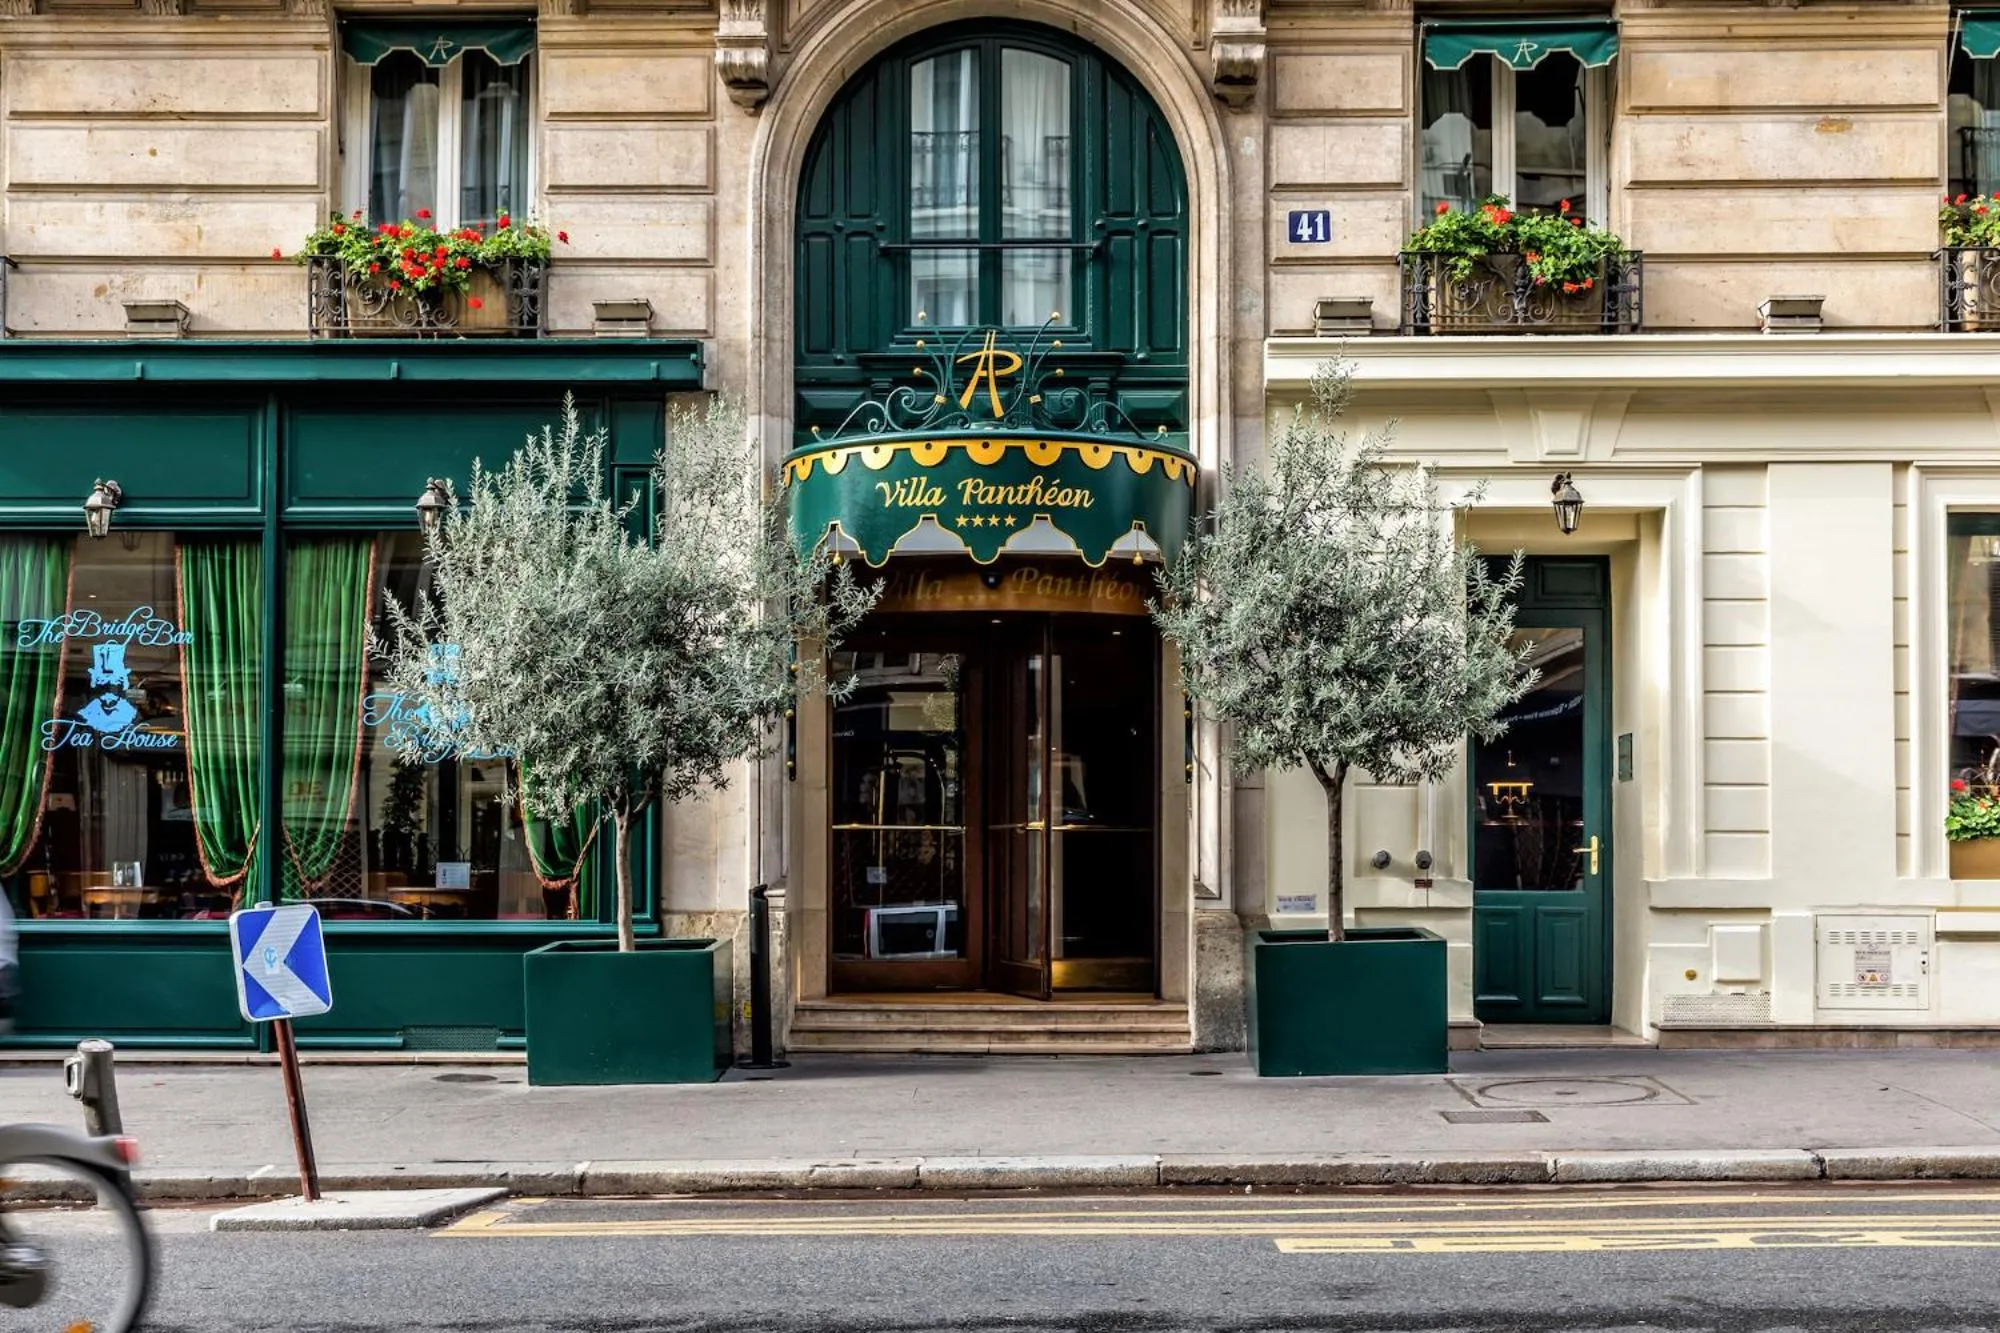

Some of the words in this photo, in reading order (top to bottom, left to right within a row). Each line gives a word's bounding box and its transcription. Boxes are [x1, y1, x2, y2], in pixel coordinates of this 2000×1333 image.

[1296, 212, 1325, 241] 41
[875, 476, 947, 508] Villa
[957, 475, 1095, 509] Panthéon
[18, 615, 74, 648] The
[65, 606, 154, 648] Bridge
[139, 619, 195, 647] Bar
[363, 691, 418, 726] The
[41, 719, 95, 751] Tea
[101, 723, 179, 751] House
